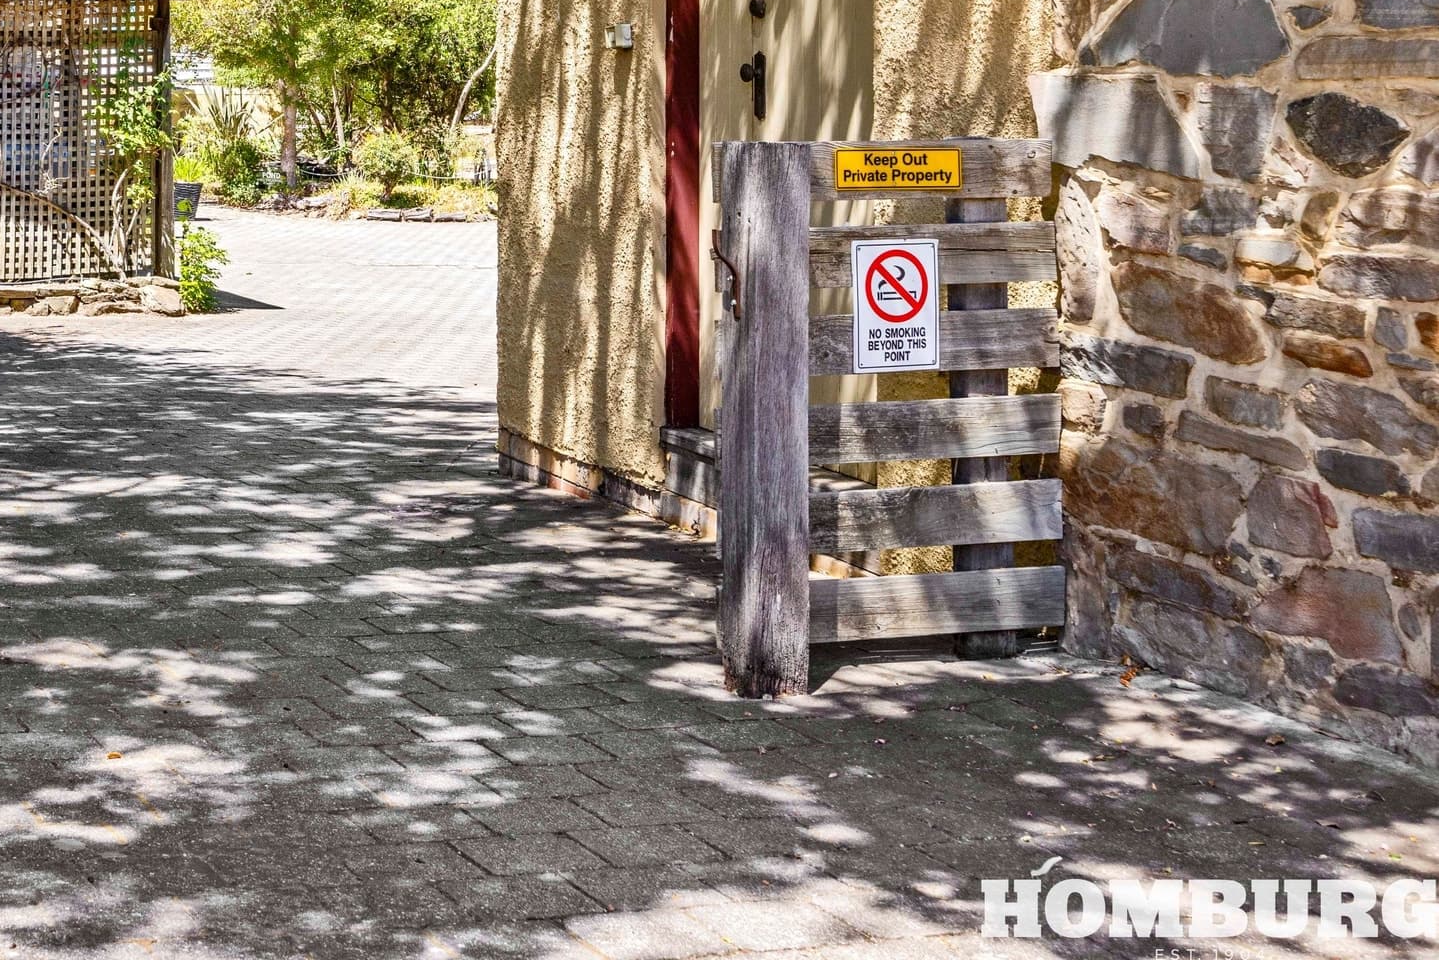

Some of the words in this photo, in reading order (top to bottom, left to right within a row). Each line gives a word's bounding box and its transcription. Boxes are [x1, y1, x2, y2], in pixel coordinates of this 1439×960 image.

[864, 153, 898, 168] Keep
[902, 153, 928, 166] Out
[843, 169, 888, 182] Private
[892, 169, 953, 184] Property
[868, 328, 882, 339] NO
[885, 327, 926, 338] SMOKING
[868, 340, 904, 351] BEYOND
[907, 338, 927, 349] THIS
[884, 351, 911, 362] POINT
